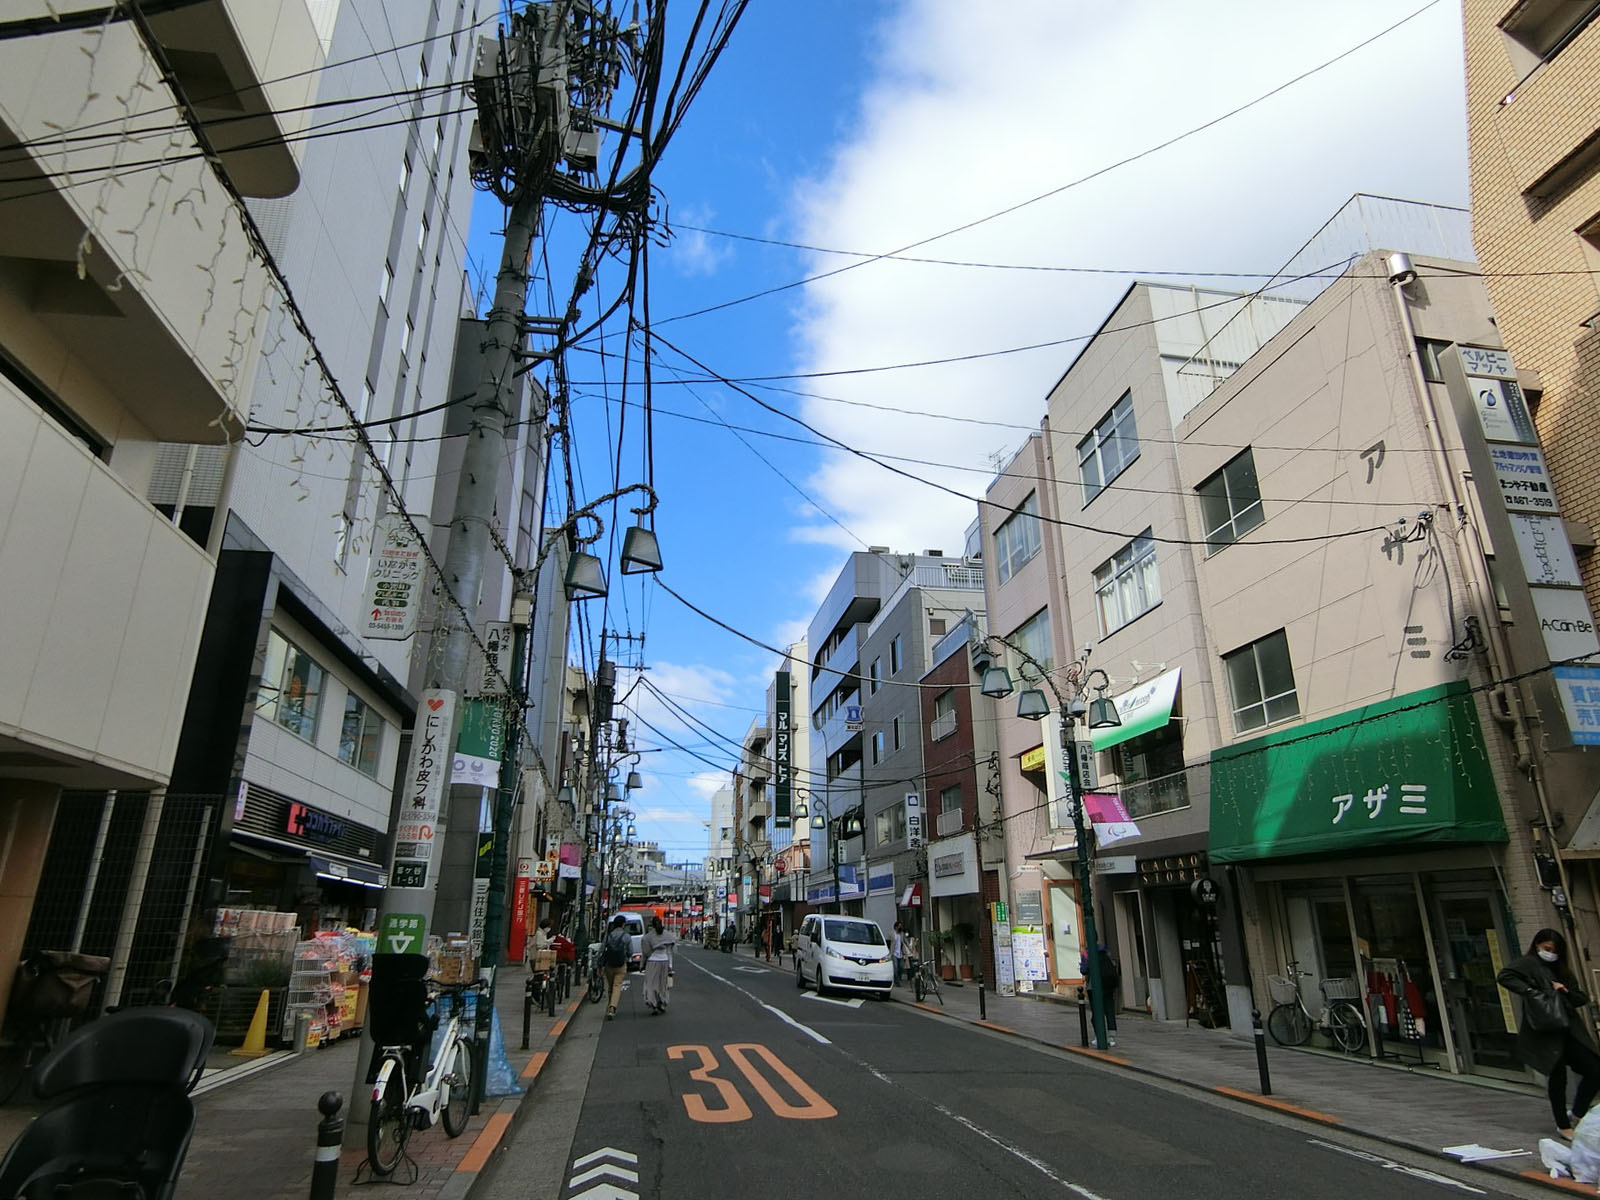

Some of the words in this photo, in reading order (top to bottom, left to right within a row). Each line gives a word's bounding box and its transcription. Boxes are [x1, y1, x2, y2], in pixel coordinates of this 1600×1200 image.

[373, 569, 419, 580] クリニック
[488, 735, 499, 757] 2020
[777, 712, 788, 784] マルマンストア
[411, 714, 440, 810] にしかわ皮フ科
[1331, 783, 1428, 824] アザミ
[1140, 854, 1199, 872] CACAO
[1142, 868, 1199, 885] STORE
[665, 1042, 839, 1123] 30
